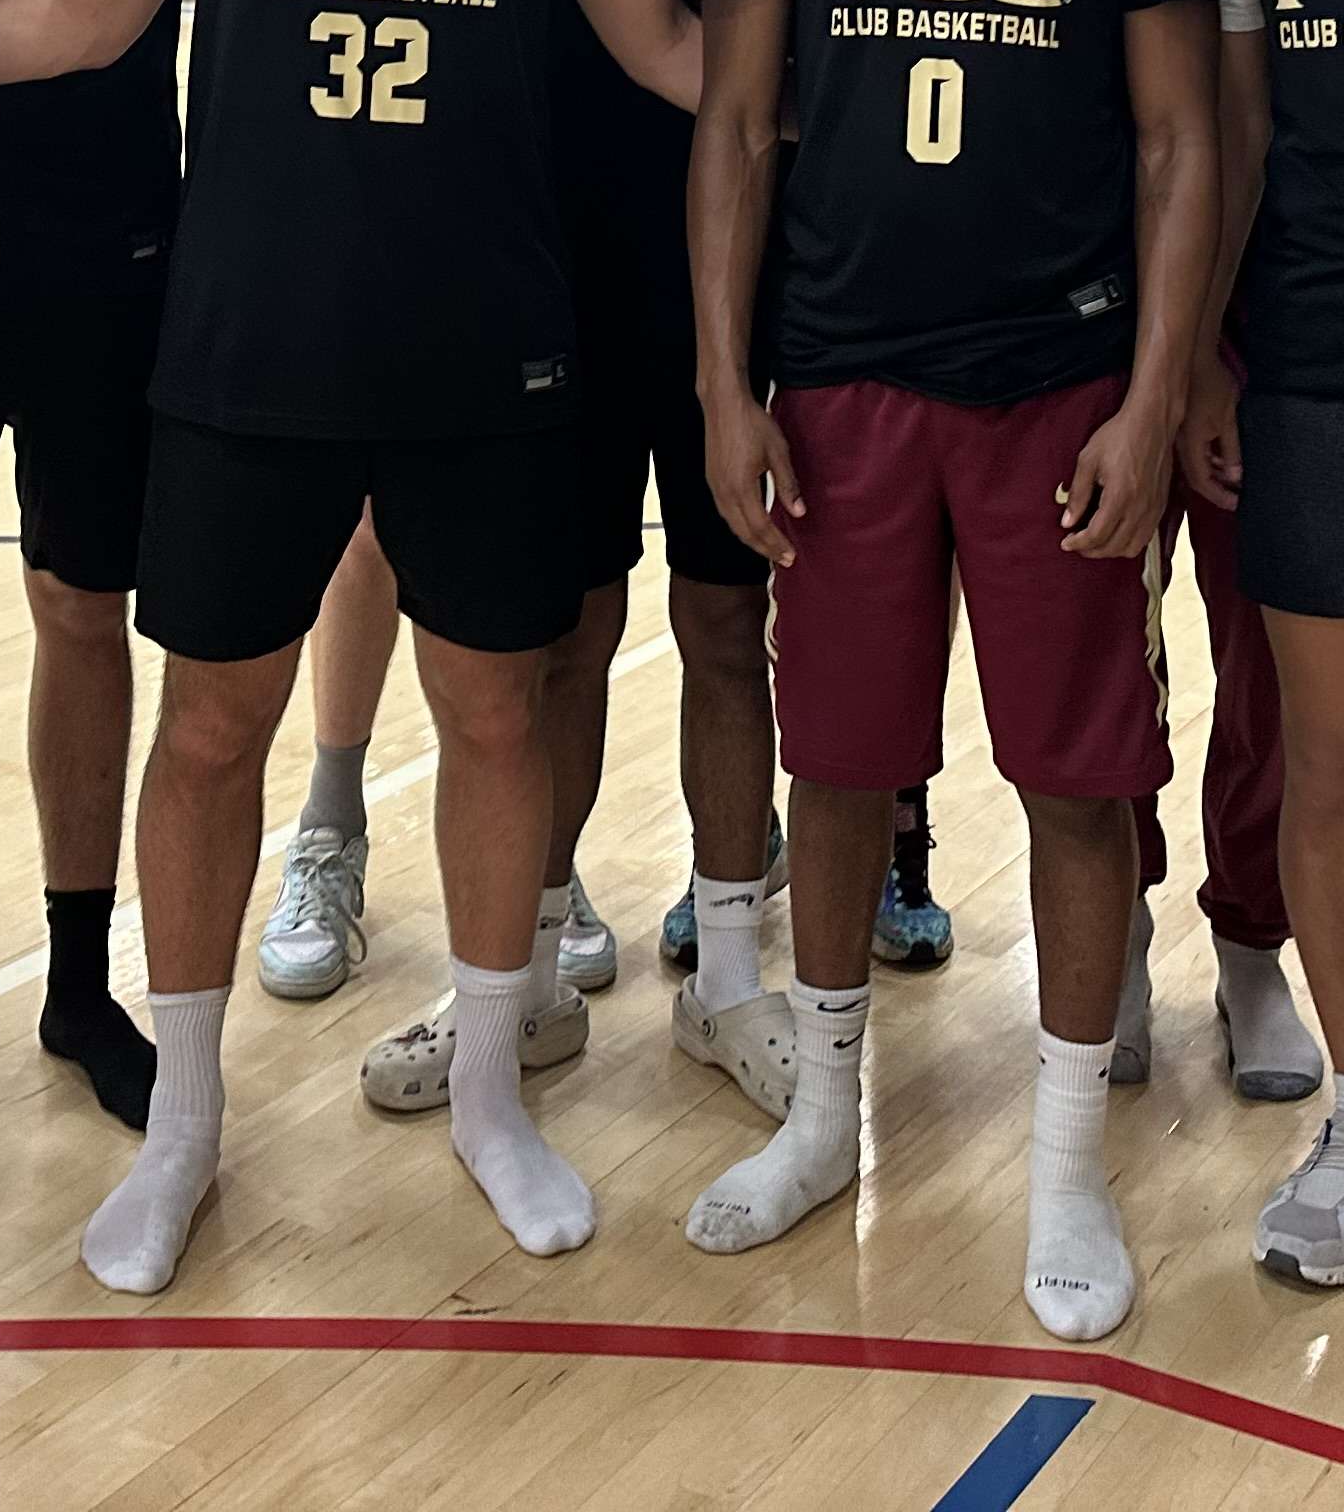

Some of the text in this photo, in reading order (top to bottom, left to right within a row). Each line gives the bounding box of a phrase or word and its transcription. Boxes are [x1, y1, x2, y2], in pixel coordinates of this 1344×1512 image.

[830, 7, 1059, 49] CLUB BASKETBALL
[1279, 18, 1337, 49] CLUB
[309, 11, 430, 124] 32
[906, 57, 964, 165] 0
